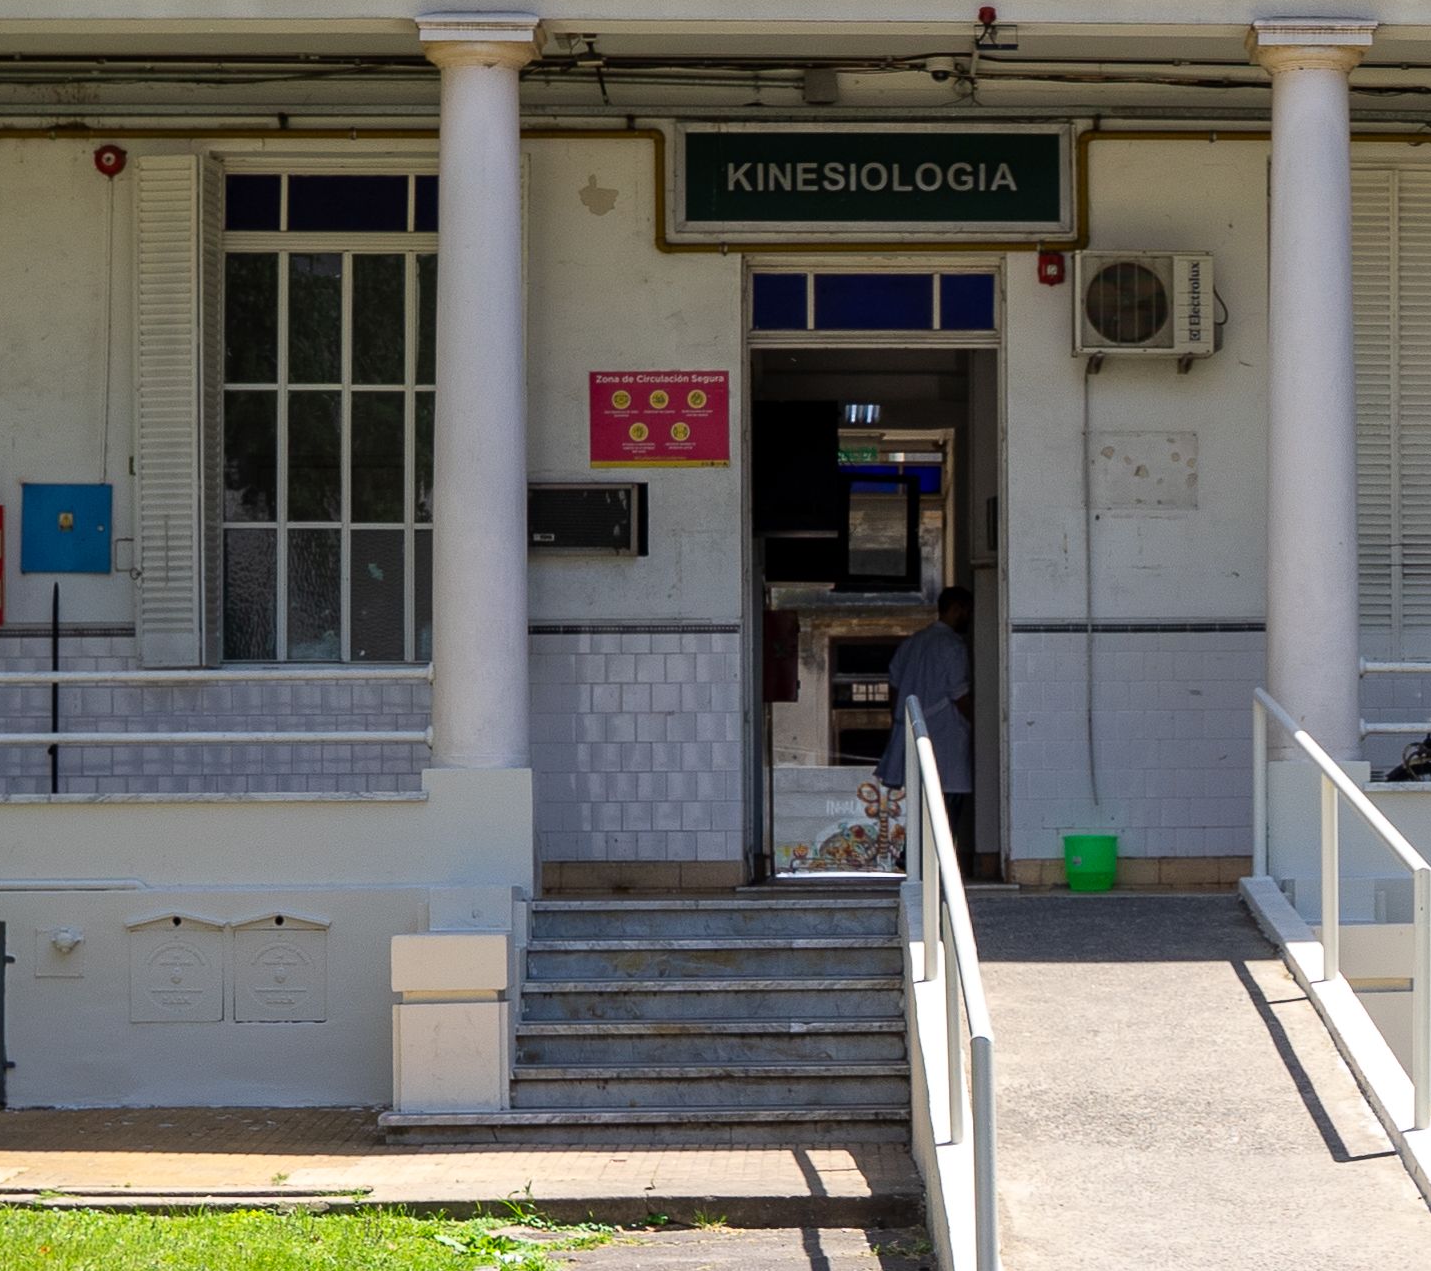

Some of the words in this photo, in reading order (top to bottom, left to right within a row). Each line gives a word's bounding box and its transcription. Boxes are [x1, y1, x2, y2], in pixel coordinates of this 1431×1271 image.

[727, 162, 1018, 193] KINESIOLOGIA
[1189, 261, 1200, 326] Electrolux
[596, 375, 620, 384] Zona
[622, 375, 634, 384] de
[636, 374, 689, 384] Circulación
[691, 374, 724, 385] Segura
